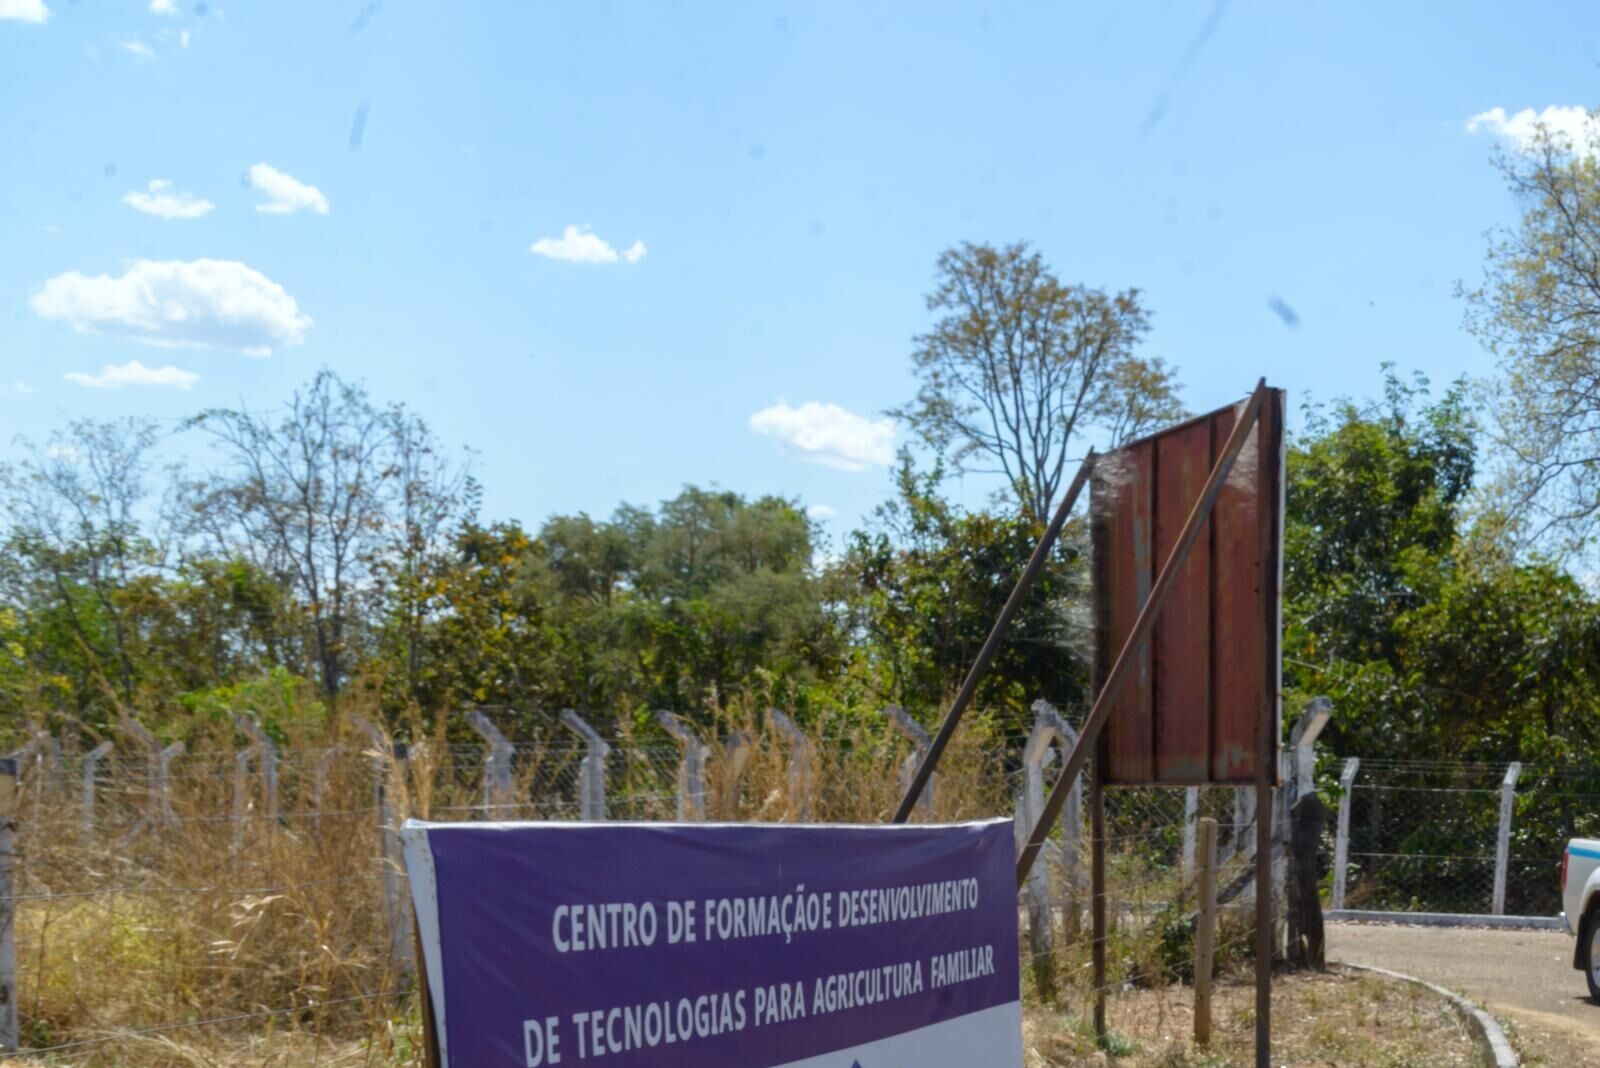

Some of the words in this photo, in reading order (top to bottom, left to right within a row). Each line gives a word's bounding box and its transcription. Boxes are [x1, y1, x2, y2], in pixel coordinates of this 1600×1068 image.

[552, 901, 657, 952] CENTRO
[667, 900, 696, 944] DE
[705, 884, 820, 944] FORMAÇÃO
[823, 892, 832, 929] E
[839, 877, 978, 928] DESENVOLVIMENTO
[523, 1016, 561, 1068] DE
[572, 989, 746, 1059] TECNOLOGIAS
[755, 981, 806, 1026] PARA
[812, 960, 923, 1016] AGRICULTURA
[931, 945, 995, 989] FAMILIAR
